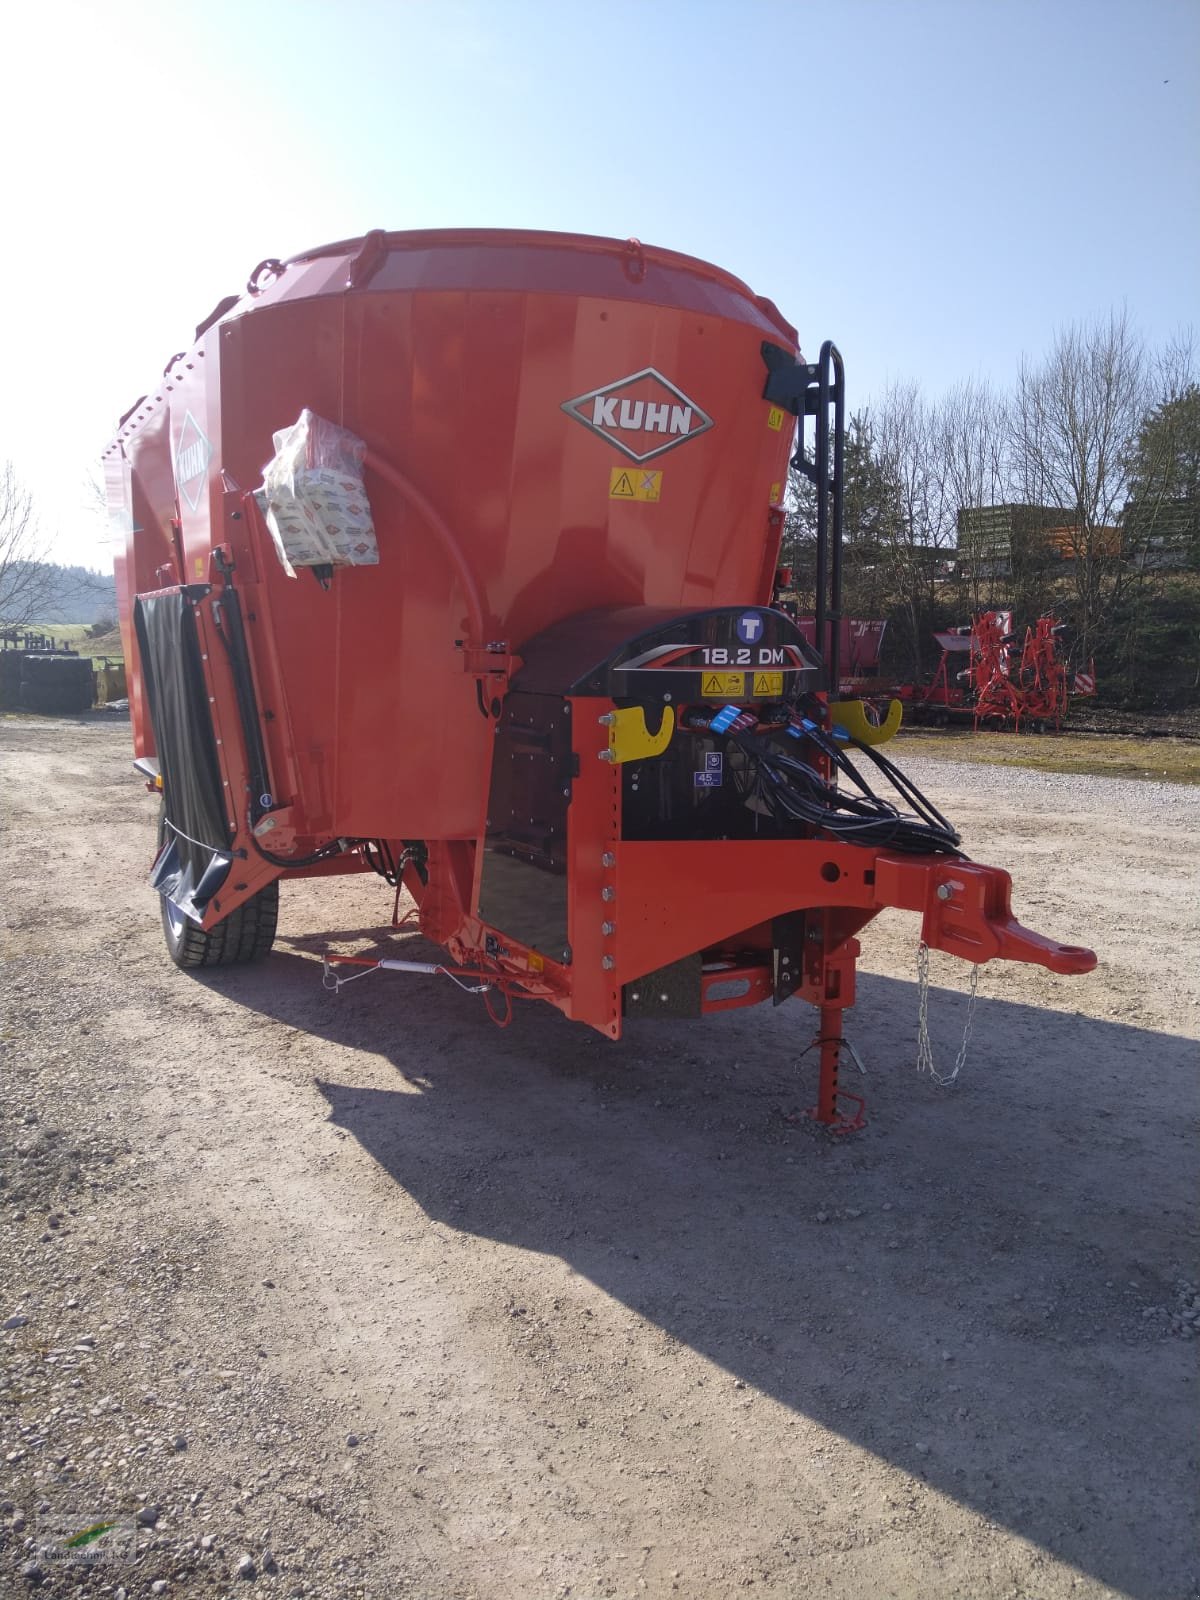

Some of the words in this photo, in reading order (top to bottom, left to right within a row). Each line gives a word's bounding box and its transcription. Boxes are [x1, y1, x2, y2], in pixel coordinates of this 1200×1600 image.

[592, 395, 692, 435] KUHN
[702, 648, 751, 665] 18.2
[758, 648, 784, 665] DM
[698, 773, 713, 782] 45
